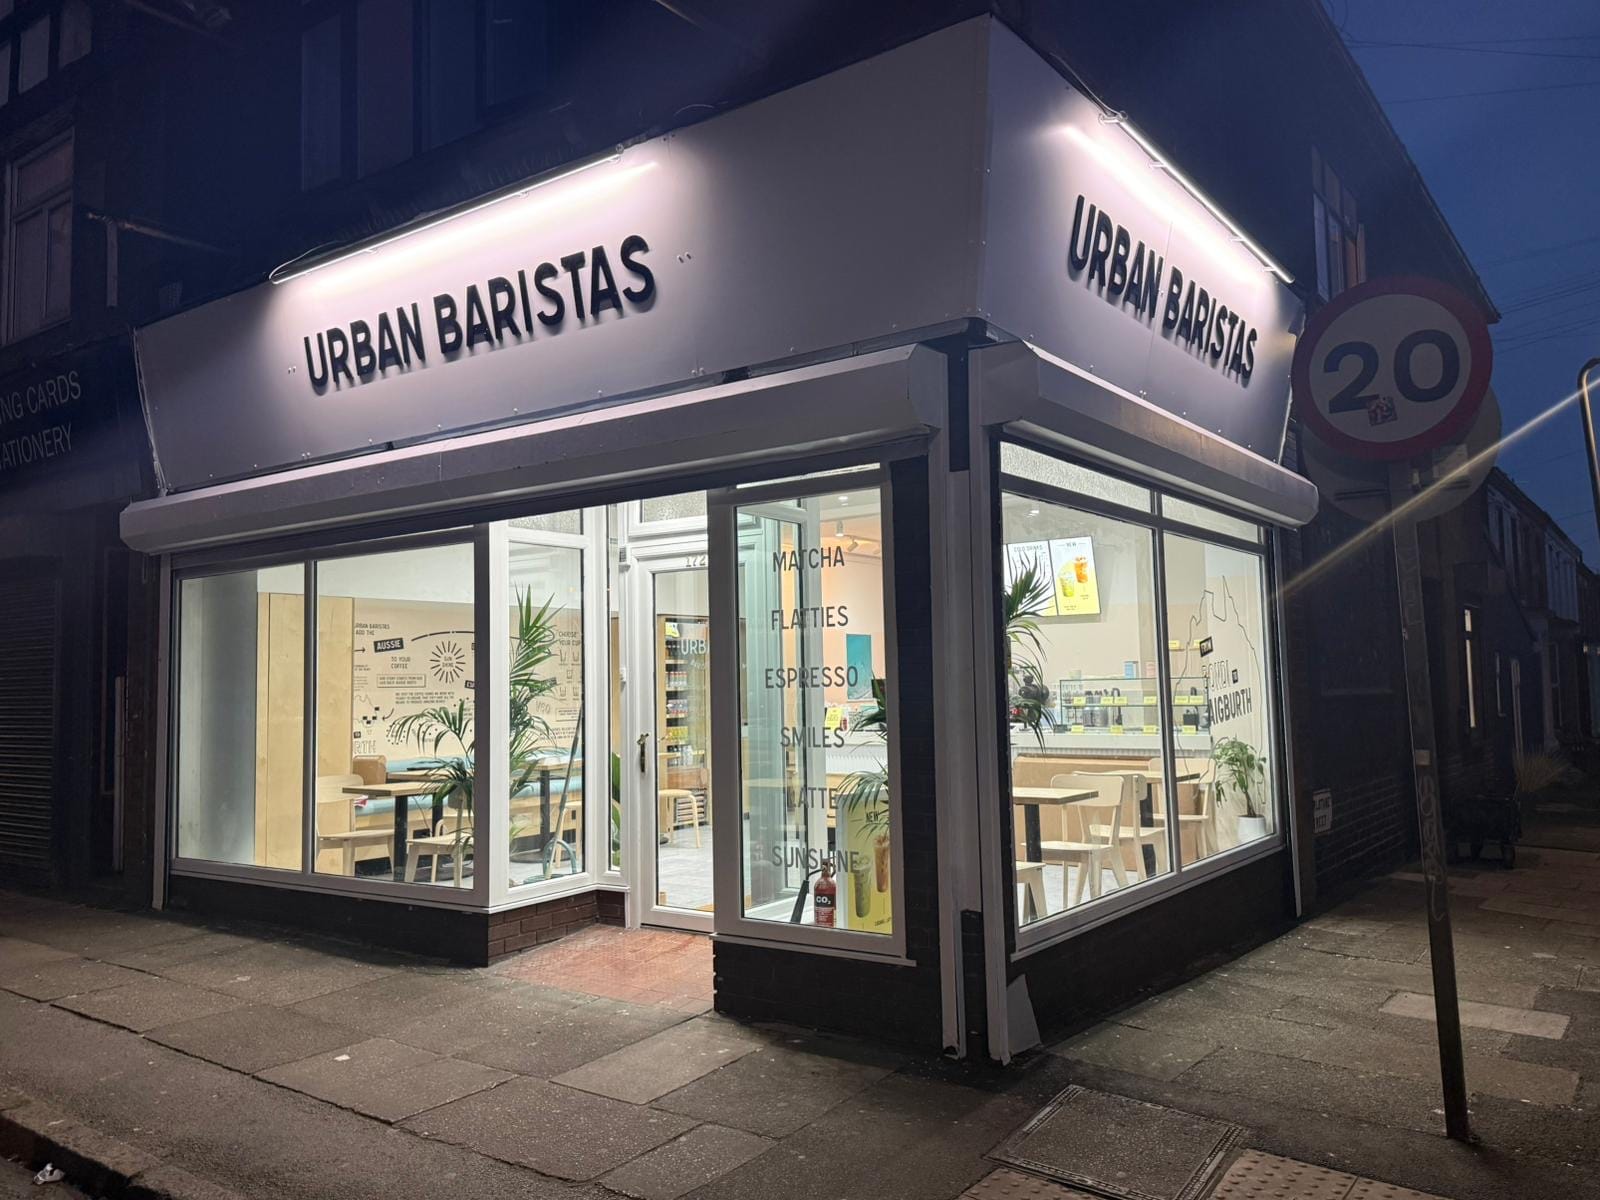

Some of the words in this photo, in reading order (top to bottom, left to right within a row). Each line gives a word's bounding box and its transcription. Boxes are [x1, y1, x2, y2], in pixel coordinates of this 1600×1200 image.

[1069, 193, 1164, 319] URBAN
[1163, 265, 1258, 380] BARISTAS
[303, 302, 426, 387] URBAN
[433, 234, 656, 356] BARISTAS
[1323, 328, 1460, 414] 20
[27, 370, 81, 414] CARDS
[0, 421, 72, 470] ATIONERY
[772, 546, 846, 573] MATCHA
[771, 606, 848, 630] FLATTIES
[375, 640, 402, 651] AUSSIE
[681, 639, 710, 655] URB
[765, 665, 858, 688] ESPRESSO
[1209, 687, 1252, 725] AIGBURTH
[780, 726, 845, 748] SMILES
[771, 846, 861, 874] SUNSHINE
